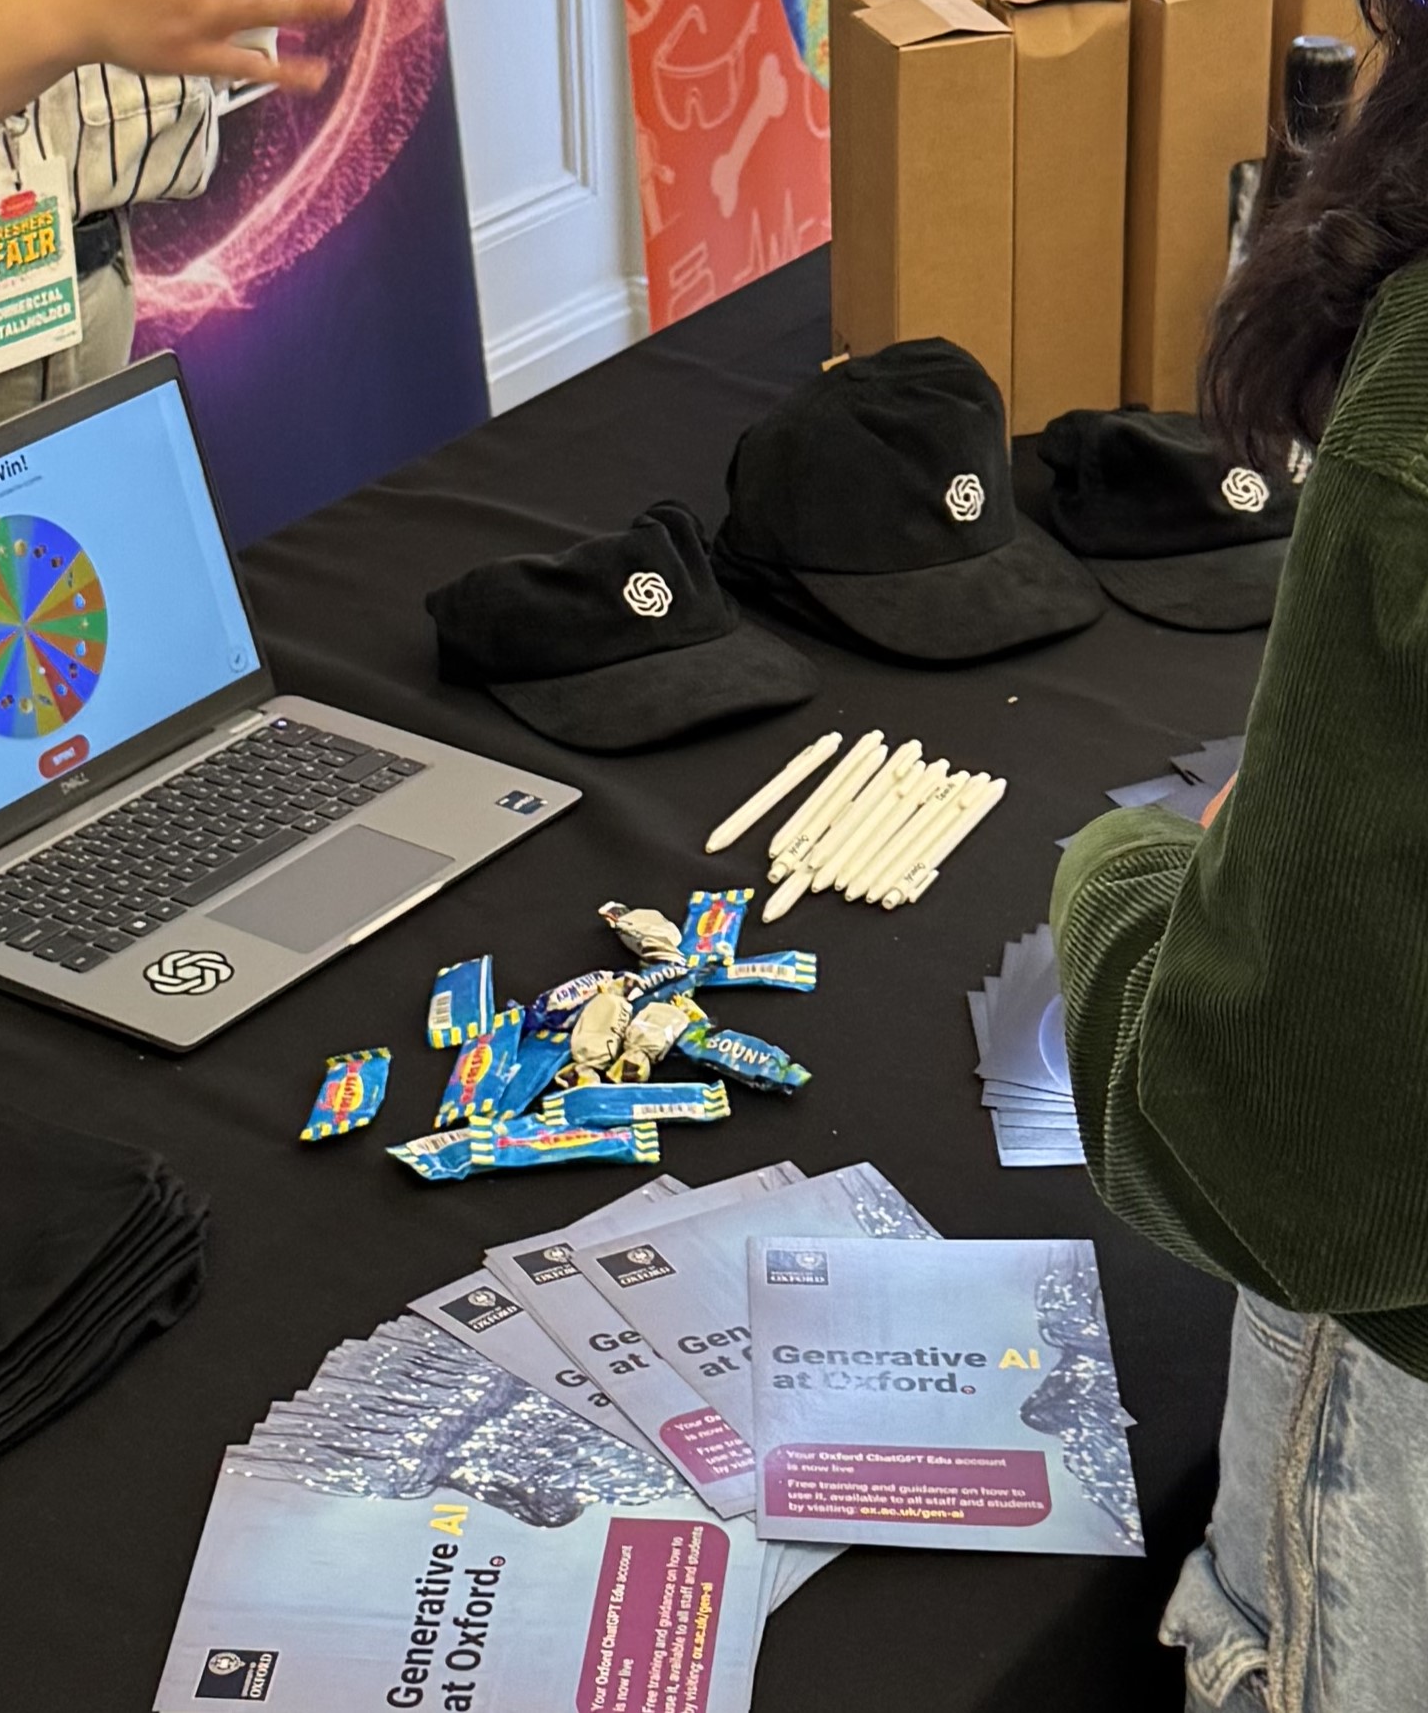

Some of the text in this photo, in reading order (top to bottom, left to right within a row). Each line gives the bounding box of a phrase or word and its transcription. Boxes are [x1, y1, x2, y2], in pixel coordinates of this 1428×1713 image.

[620, 1266, 671, 1287] OXFORD
[473, 1305, 518, 1332] OXFORD
[608, 1352, 650, 1375] at
[699, 1354, 740, 1377] at
[772, 1345, 1041, 1369] Generative AI
[772, 1373, 812, 1390] at
[786, 1450, 1006, 1466] Your Oxford ChatGPT Edu account
[787, 1464, 798, 1472] is
[832, 1464, 854, 1474] live
[788, 1479, 1026, 1497] Free training and guidance on how to
[788, 1492, 813, 1500] use
[830, 1493, 887, 1504] available
[890, 1495, 904, 1504] to
[907, 1496, 923, 1505] all
[925, 1497, 956, 1506] staff
[960, 1498, 985, 1507] and
[987, 1499, 1044, 1509] students
[789, 1503, 805, 1514] by
[688, 1526, 704, 1565] students
[685, 1566, 697, 1584] and
[386, 1504, 469, 1708] Generative AI
[680, 1586, 693, 1609] staff
[591, 1545, 633, 1711] Your Oxford ChatGPT Edu account
[642, 1536, 683, 1713] Free training and guidance on how to
[677, 1610, 689, 1623] all
[675, 1625, 687, 1636] to
[670, 1637, 686, 1682] available
[249, 1653, 273, 1698] OXFORD
[613, 1658, 634, 1712] is now live
[440, 1681, 476, 1712] at
[664, 1694, 677, 1713] use
